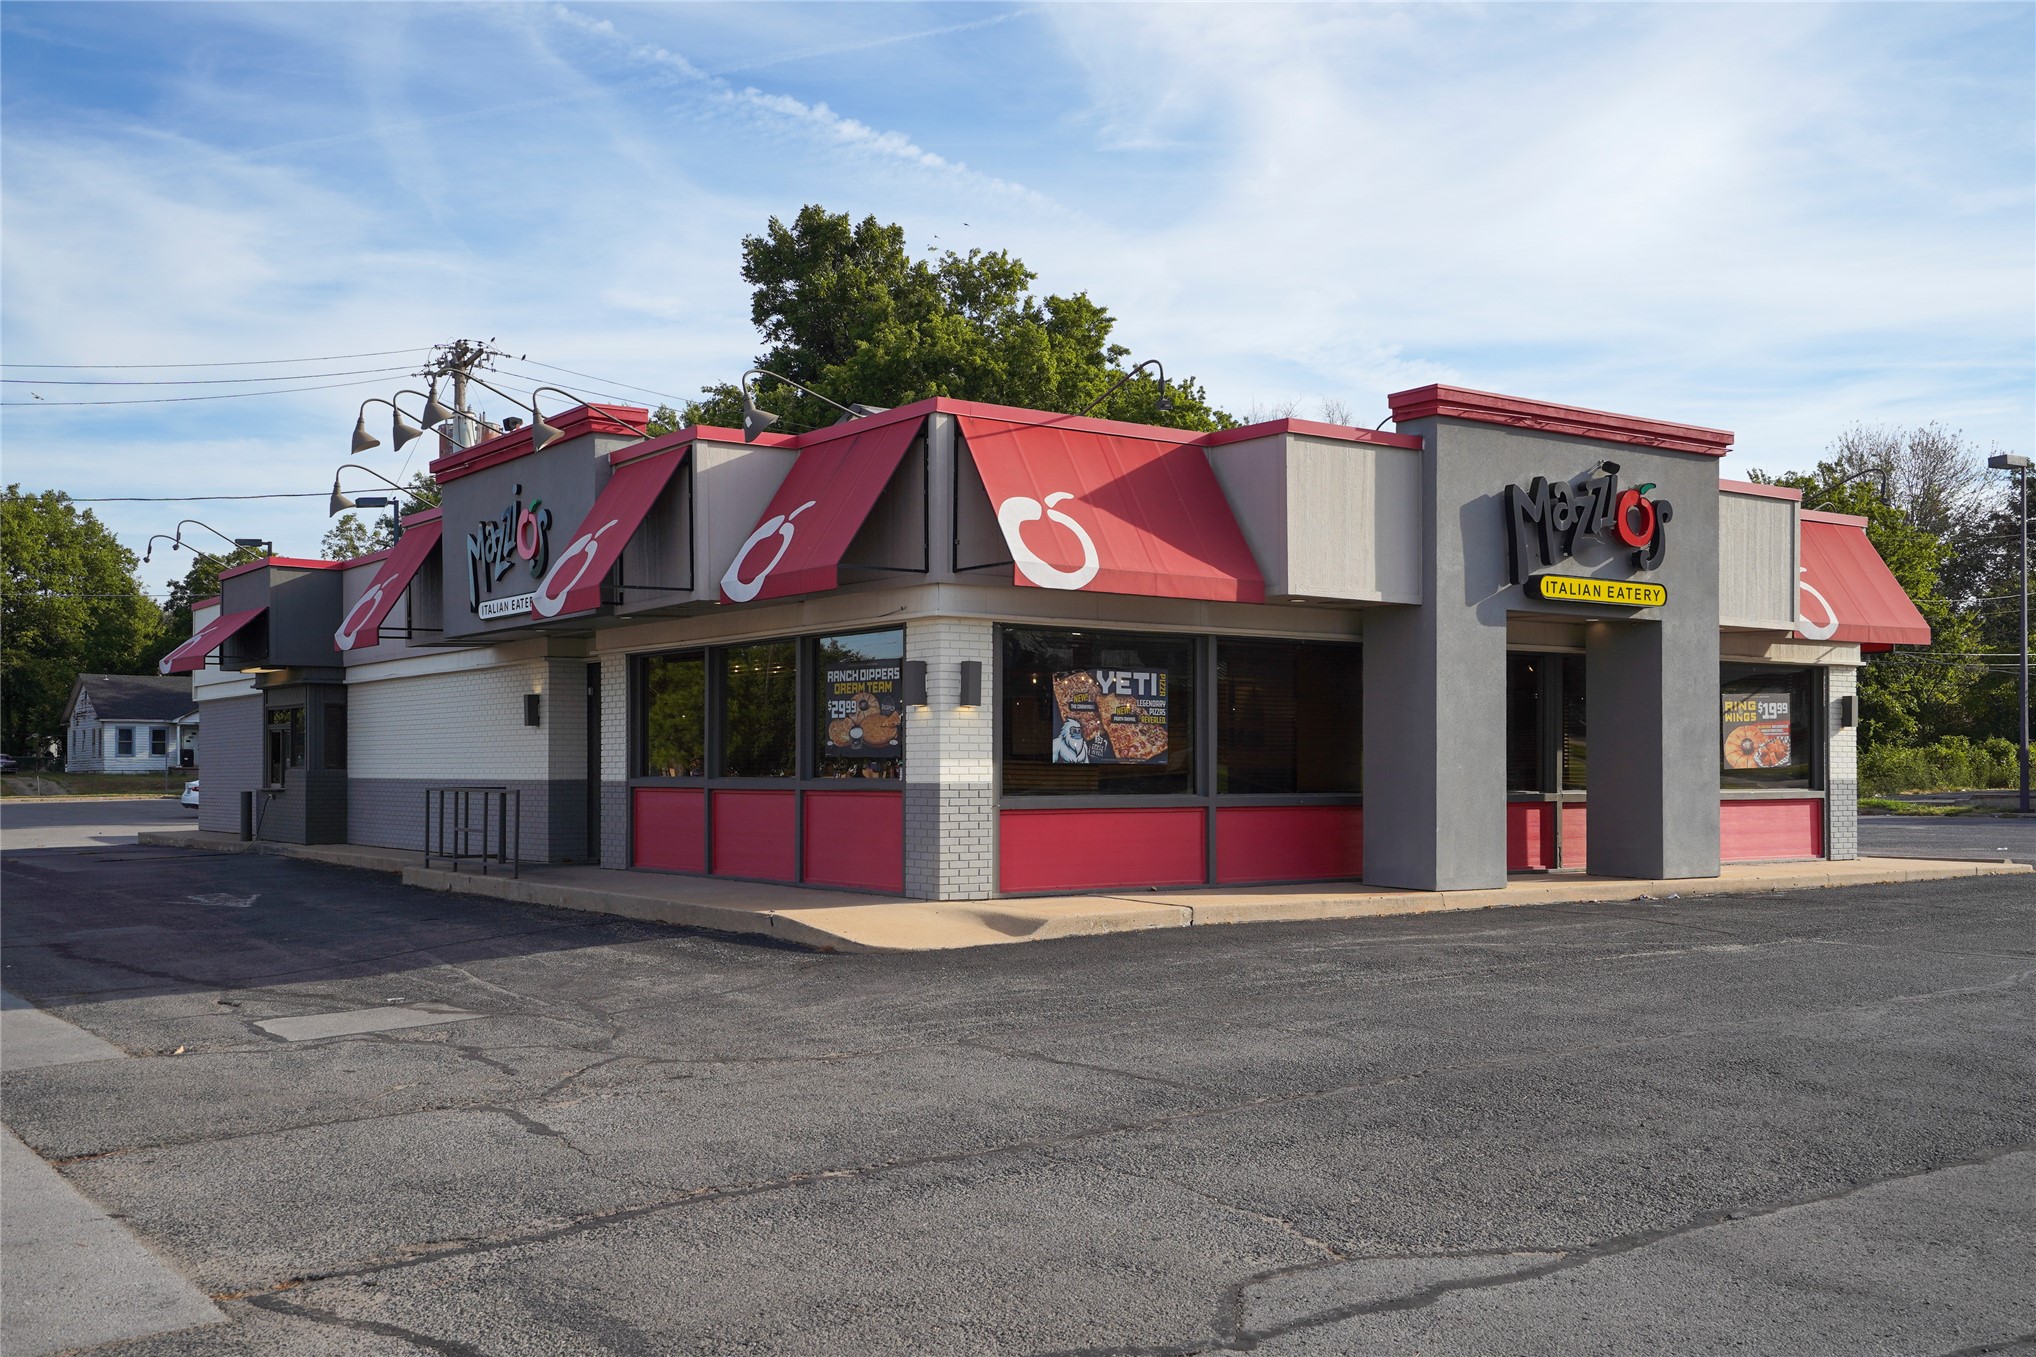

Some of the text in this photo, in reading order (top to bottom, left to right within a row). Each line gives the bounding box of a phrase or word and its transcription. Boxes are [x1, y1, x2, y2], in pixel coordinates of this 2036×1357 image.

[1545, 580, 1661, 602] ITALIAN EATERY
[481, 603, 509, 616] ITALIAN
[827, 667, 900, 682] RANCH DIPPERS
[834, 681, 892, 694] DREAM TEAM
[1096, 670, 1157, 696] YETI
[1136, 699, 1166, 708] LEGENDARY
[1724, 701, 1757, 711] RING
[1149, 708, 1166, 716] PIZZAS
[1724, 712, 1757, 722] WINGS
